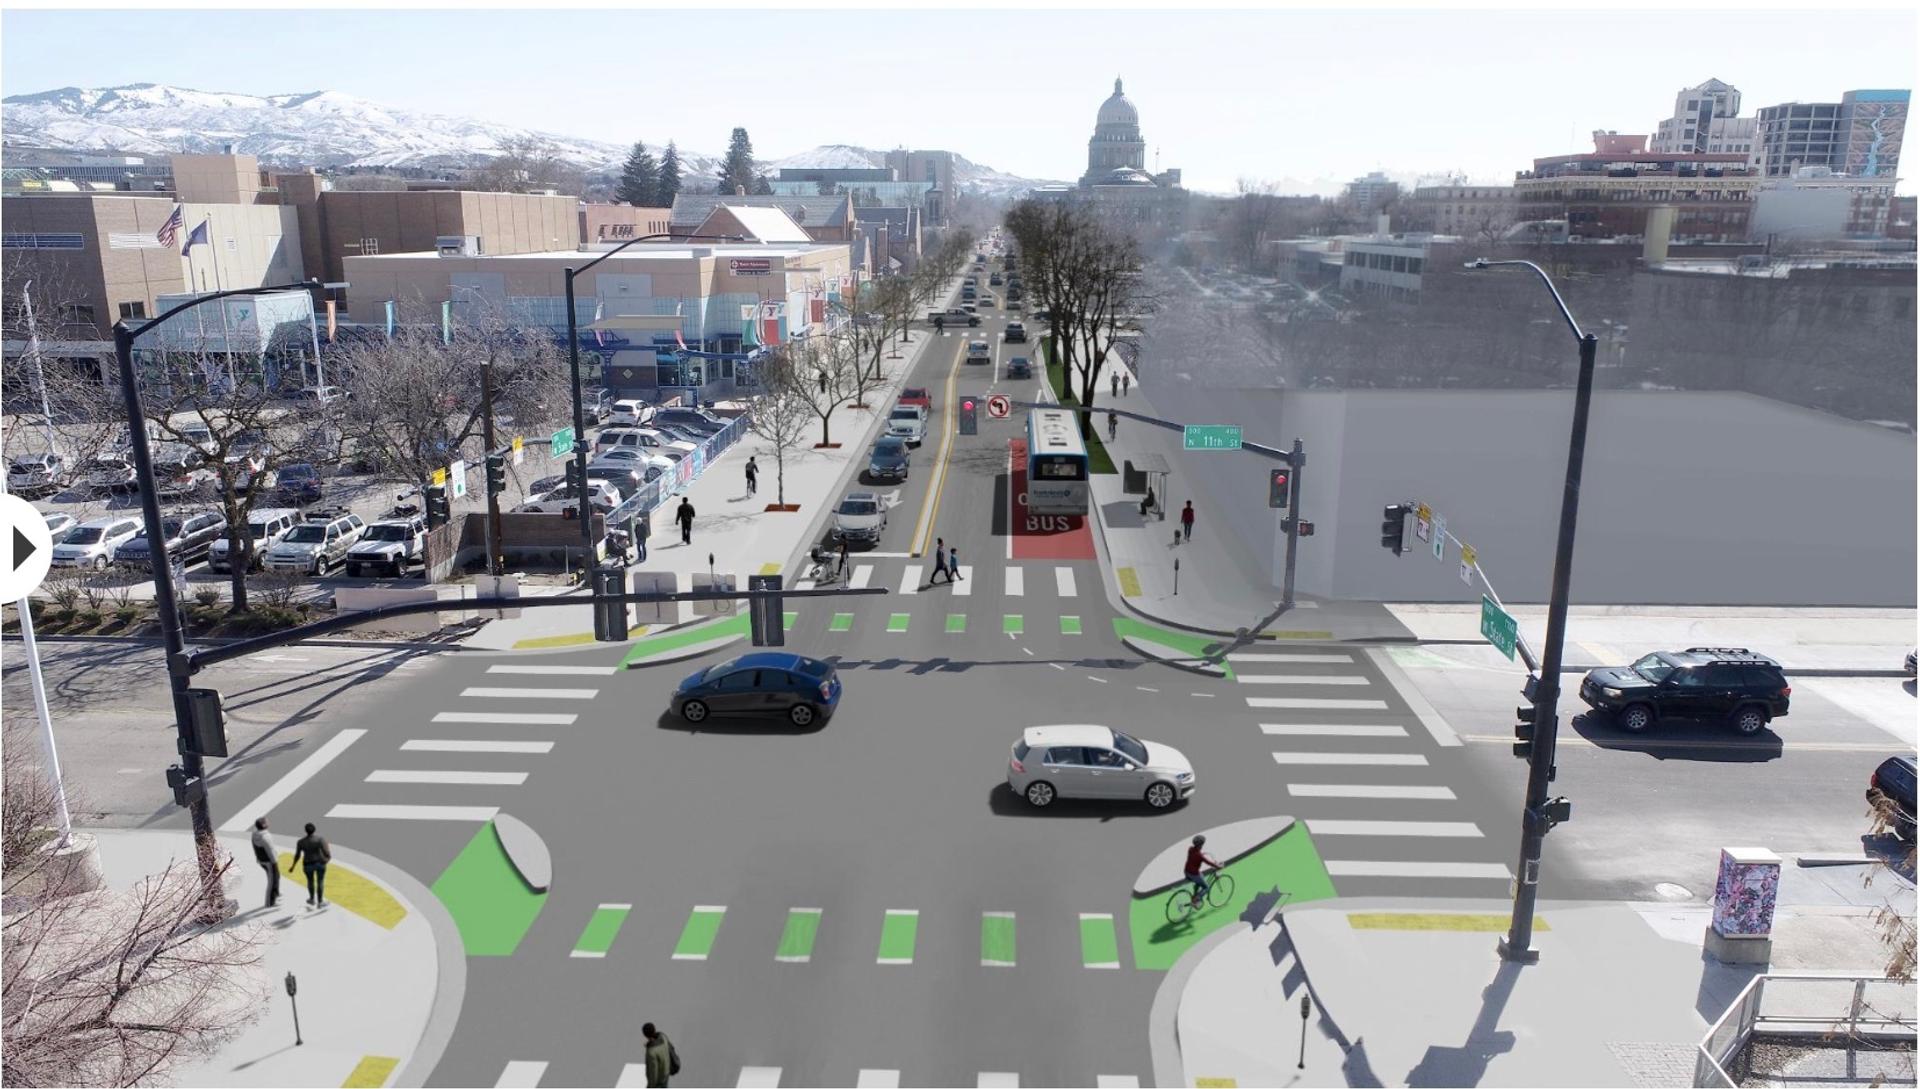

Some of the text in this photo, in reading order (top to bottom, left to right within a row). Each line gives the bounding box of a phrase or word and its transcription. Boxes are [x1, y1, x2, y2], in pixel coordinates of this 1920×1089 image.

[1188, 436, 1238, 447] N 11th St
[1026, 515, 1070, 531] BUS
[1489, 620, 1505, 648] State
